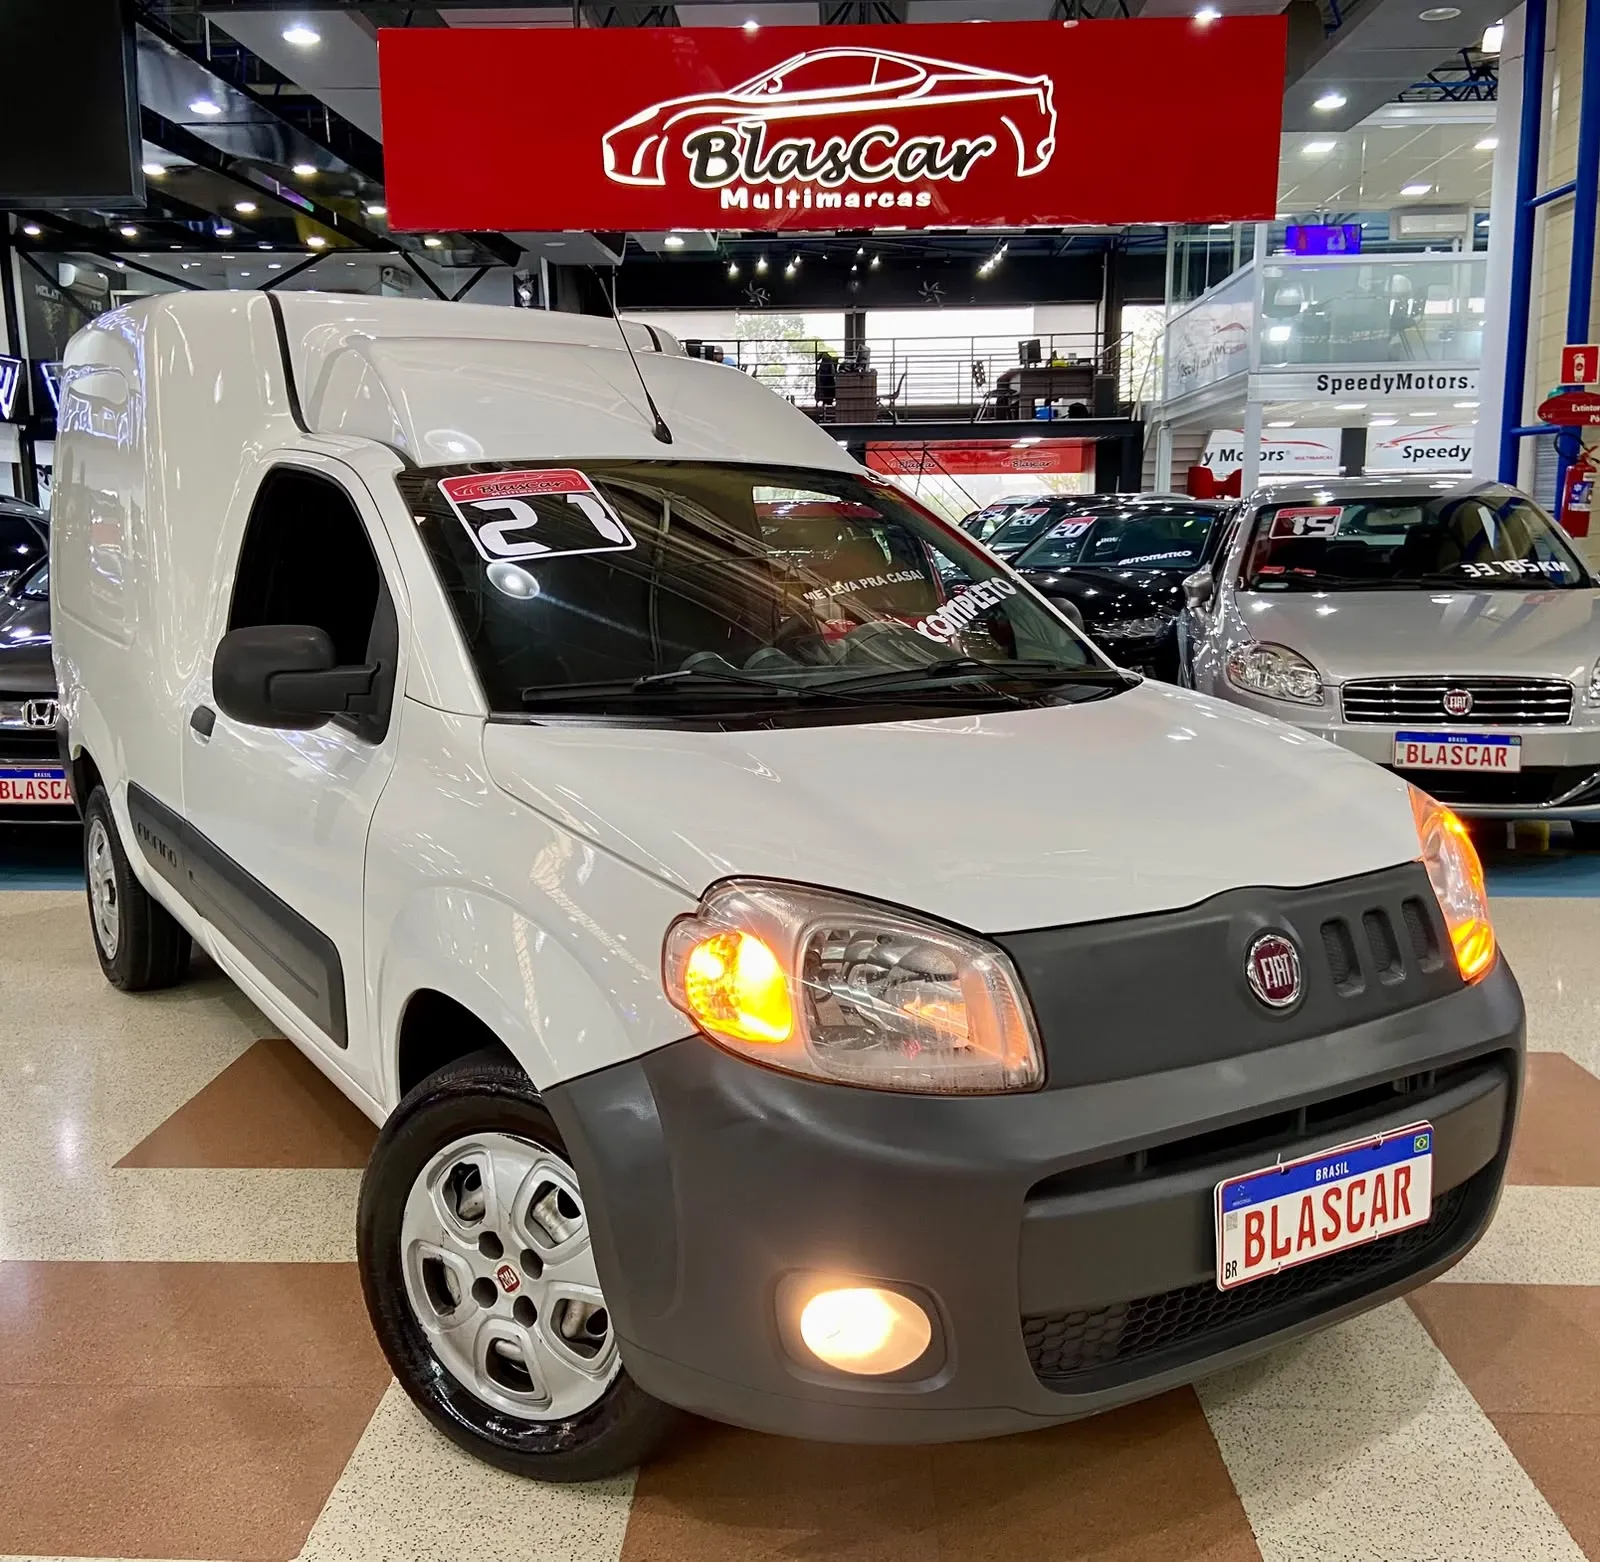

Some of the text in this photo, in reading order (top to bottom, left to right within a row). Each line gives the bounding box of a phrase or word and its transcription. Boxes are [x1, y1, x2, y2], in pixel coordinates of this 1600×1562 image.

[683, 121, 996, 188] BlasCar
[720, 187, 931, 209] Multimarcas
[1219, 448, 1284, 461] Moors
[1402, 444, 1472, 462] Speedy
[470, 494, 624, 556] 21
[1049, 523, 1089, 538] 20
[1290, 516, 1335, 535] 15
[802, 589, 826, 601] ME
[827, 581, 860, 597] LEVA
[861, 575, 886, 590] PRA
[915, 576, 1017, 643] COMPLETO
[1449, 695, 1467, 709] FIAT
[1406, 743, 1508, 767] BLASCAR
[0, 781, 71, 800] BLASCA
[1260, 953, 1292, 990] FIAT
[1315, 1161, 1349, 1182] BRASIL
[1244, 1165, 1411, 1268] BLASCAR
[1225, 1260, 1238, 1280] BR
